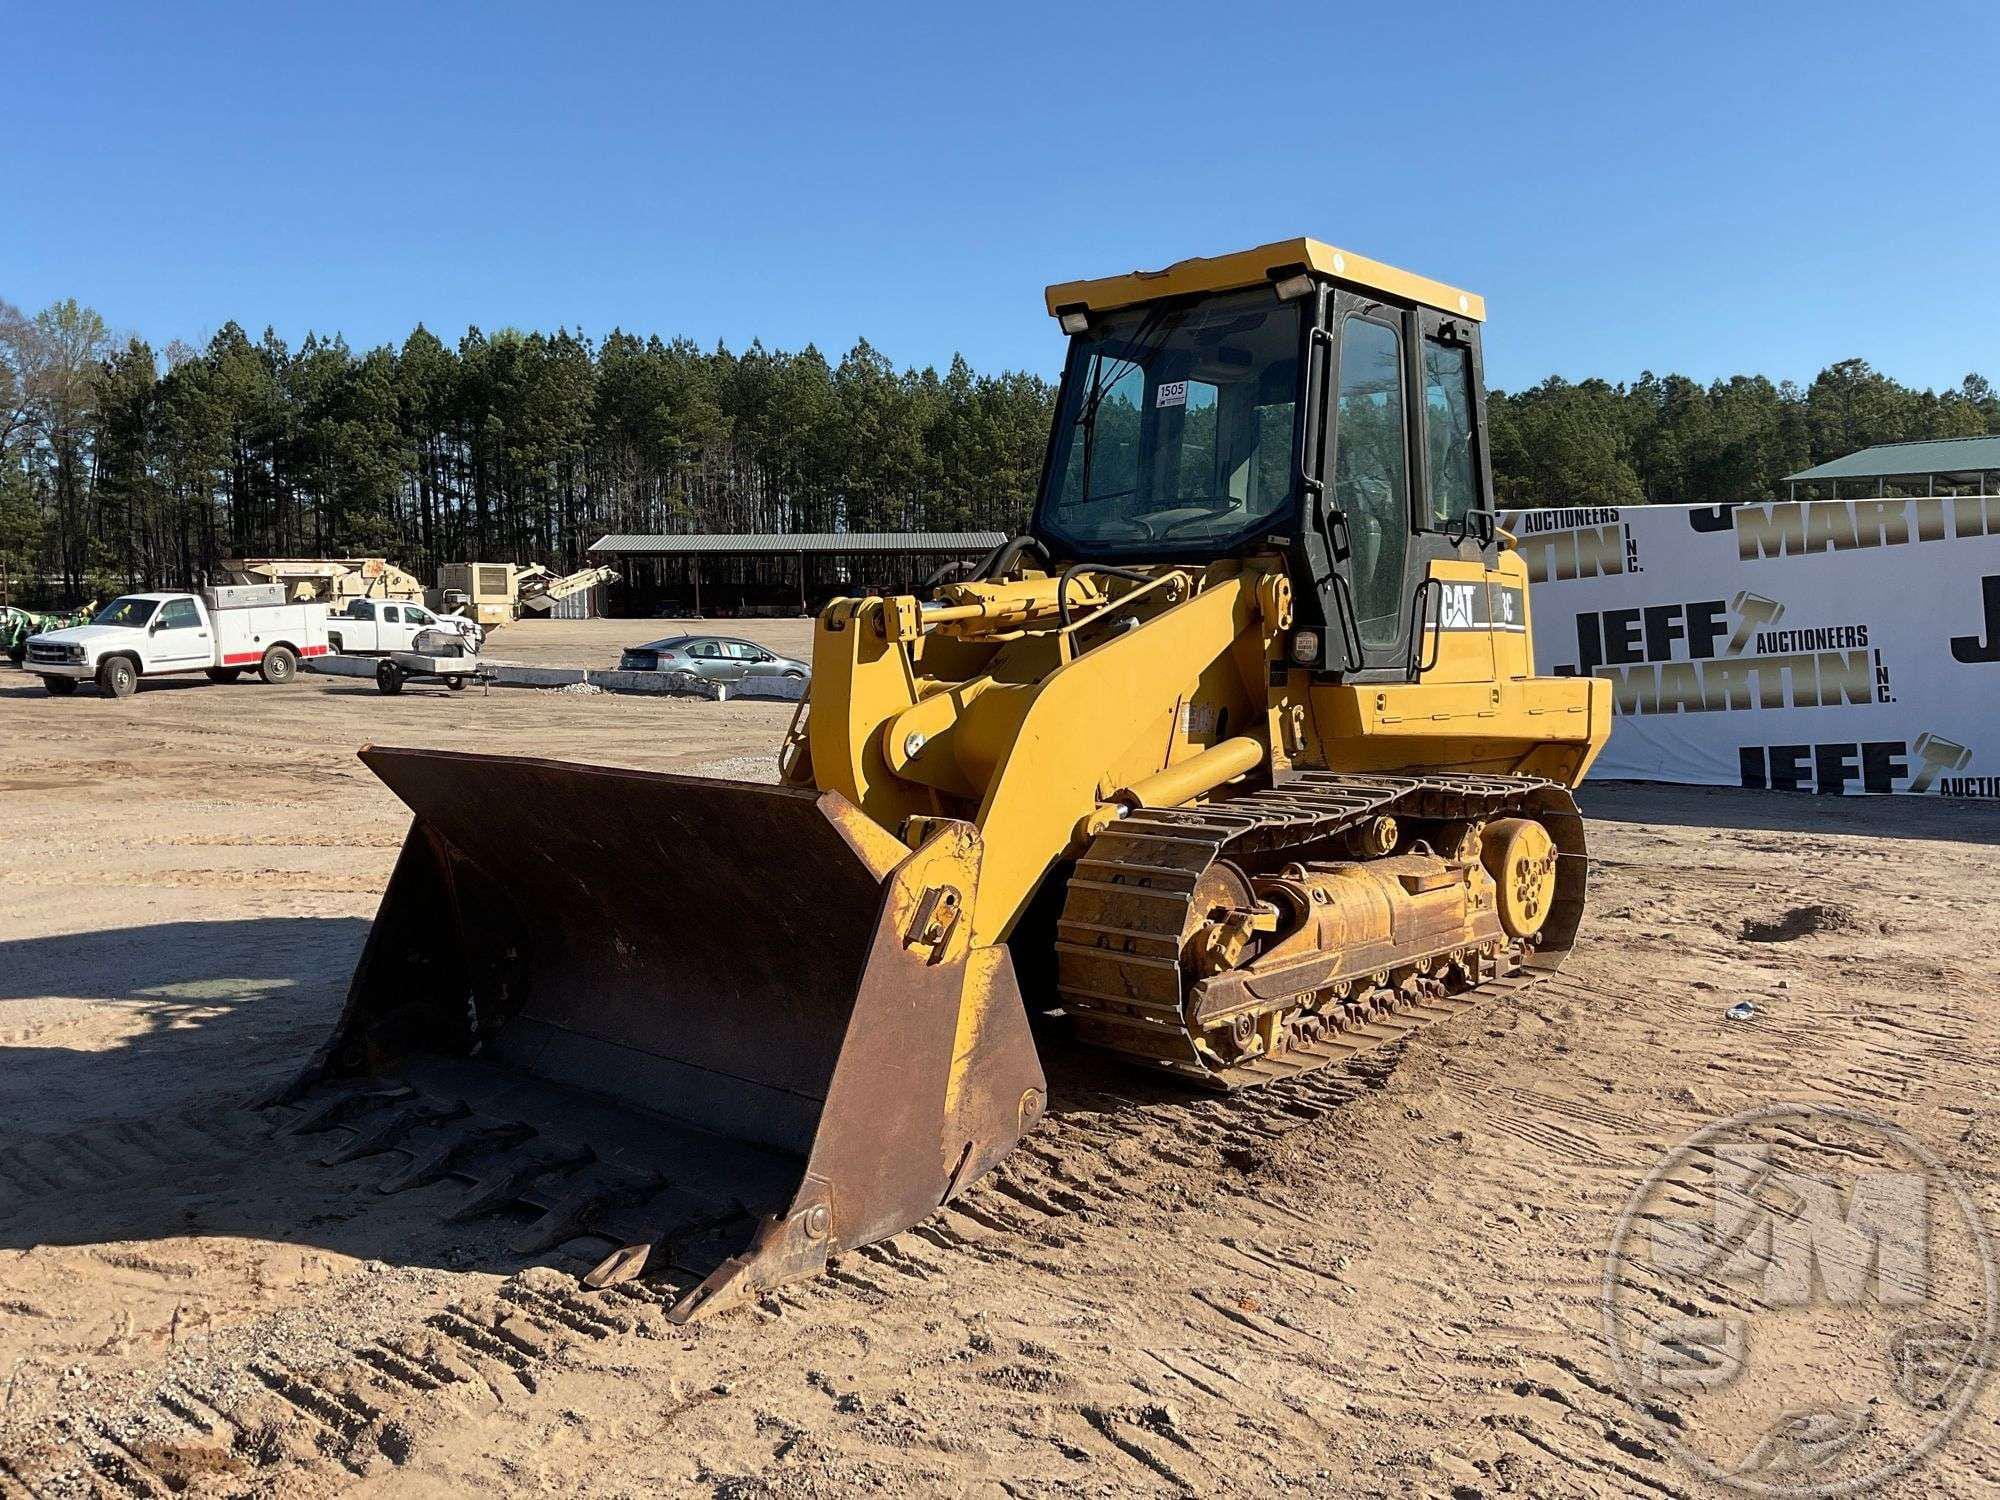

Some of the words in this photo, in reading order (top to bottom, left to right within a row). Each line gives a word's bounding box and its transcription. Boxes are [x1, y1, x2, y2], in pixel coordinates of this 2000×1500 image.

[1161, 383, 1184, 397] 1505
[1524, 507, 1620, 534] AUCTIONEERS
[1736, 499, 2000, 561] MARTI
[1441, 585, 1475, 627] CAT
[1553, 600, 1728, 677] JEFF
[1756, 624, 1869, 654] AUCTIONEERS
[1597, 650, 1873, 714] MARTIN
